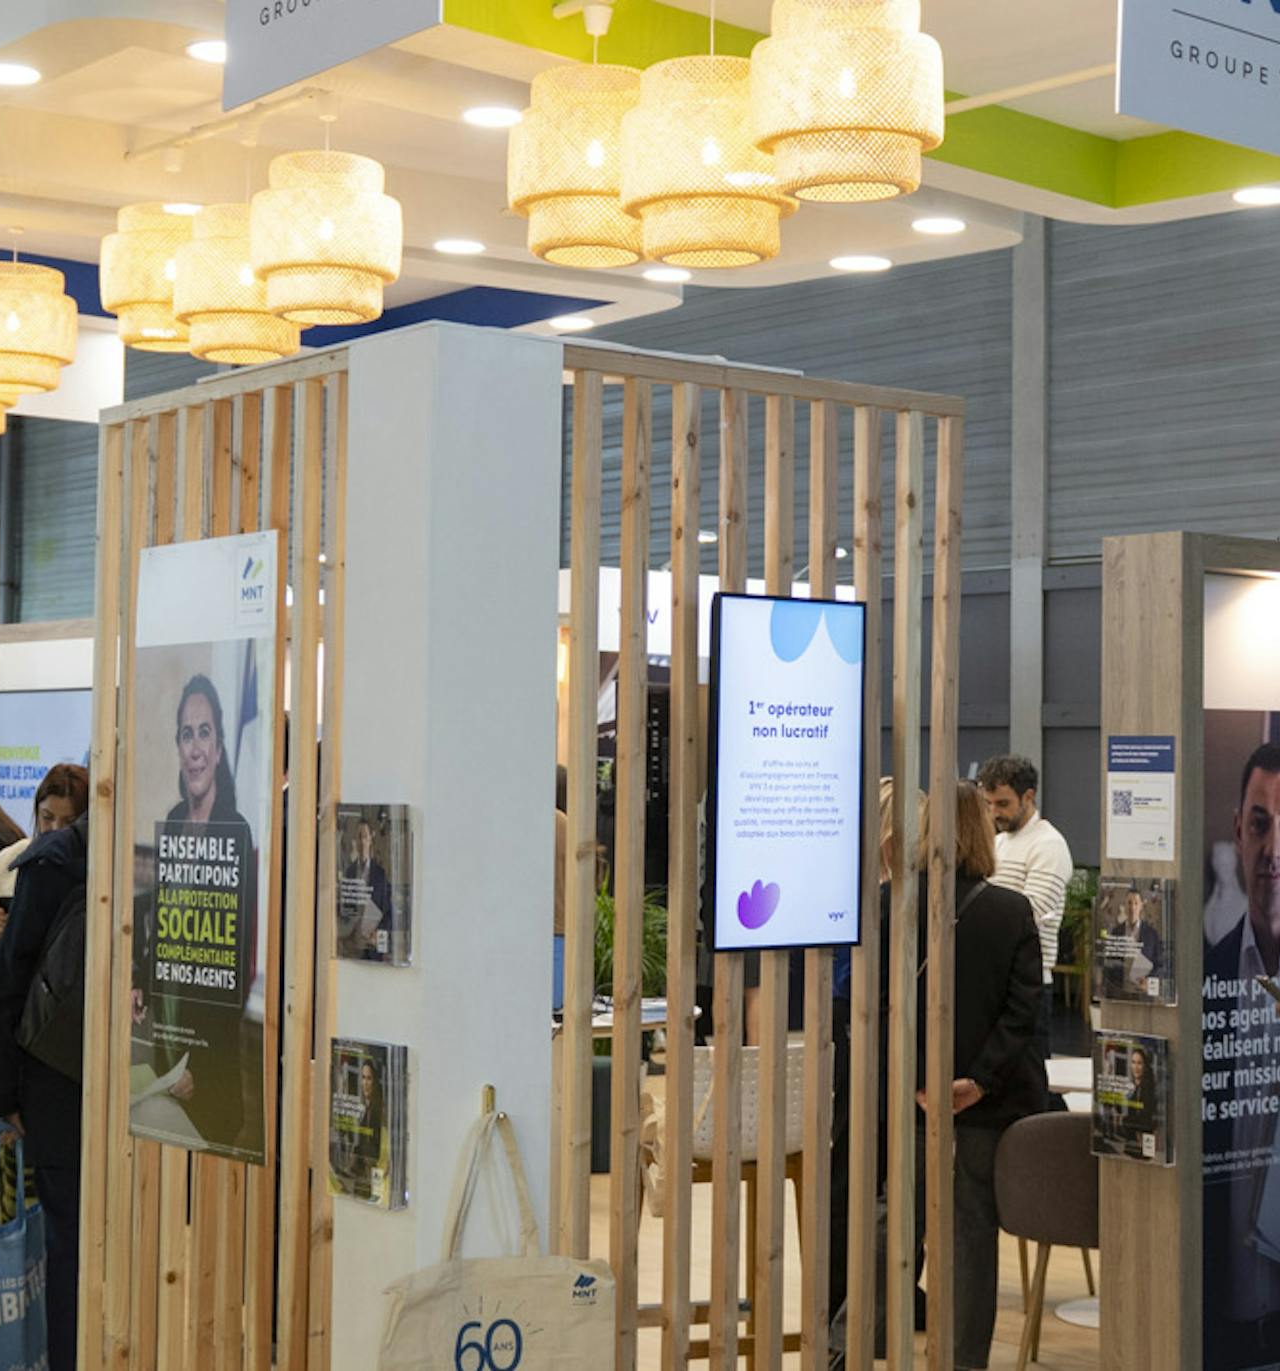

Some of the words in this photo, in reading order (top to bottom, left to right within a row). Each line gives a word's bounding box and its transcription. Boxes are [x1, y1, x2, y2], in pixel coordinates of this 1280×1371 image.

[1170, 40, 1269, 85] GROUPE
[241, 585, 264, 601] MNT
[768, 701, 833, 719] opérateur
[752, 726, 777, 737] non
[781, 724, 829, 738] lucratif
[159, 835, 240, 865] ENSEMBLE,
[158, 863, 239, 887] PARTICIPONS
[178, 890, 238, 910] PROTECTION
[157, 907, 237, 945] SOCIALE
[156, 943, 236, 967] COMPLÉMENTAIRE
[156, 962, 170, 980] DE
[171, 963, 193, 985] NOS
[194, 967, 236, 990] AGENTS
[1203, 1035, 1270, 1060] éalisent
[1202, 1073, 1230, 1091] eur
[1220, 1093, 1278, 1120] service
[572, 1289, 597, 1298] MNT
[454, 1319, 523, 1371] 60
[493, 1342, 514, 1351] ANS
